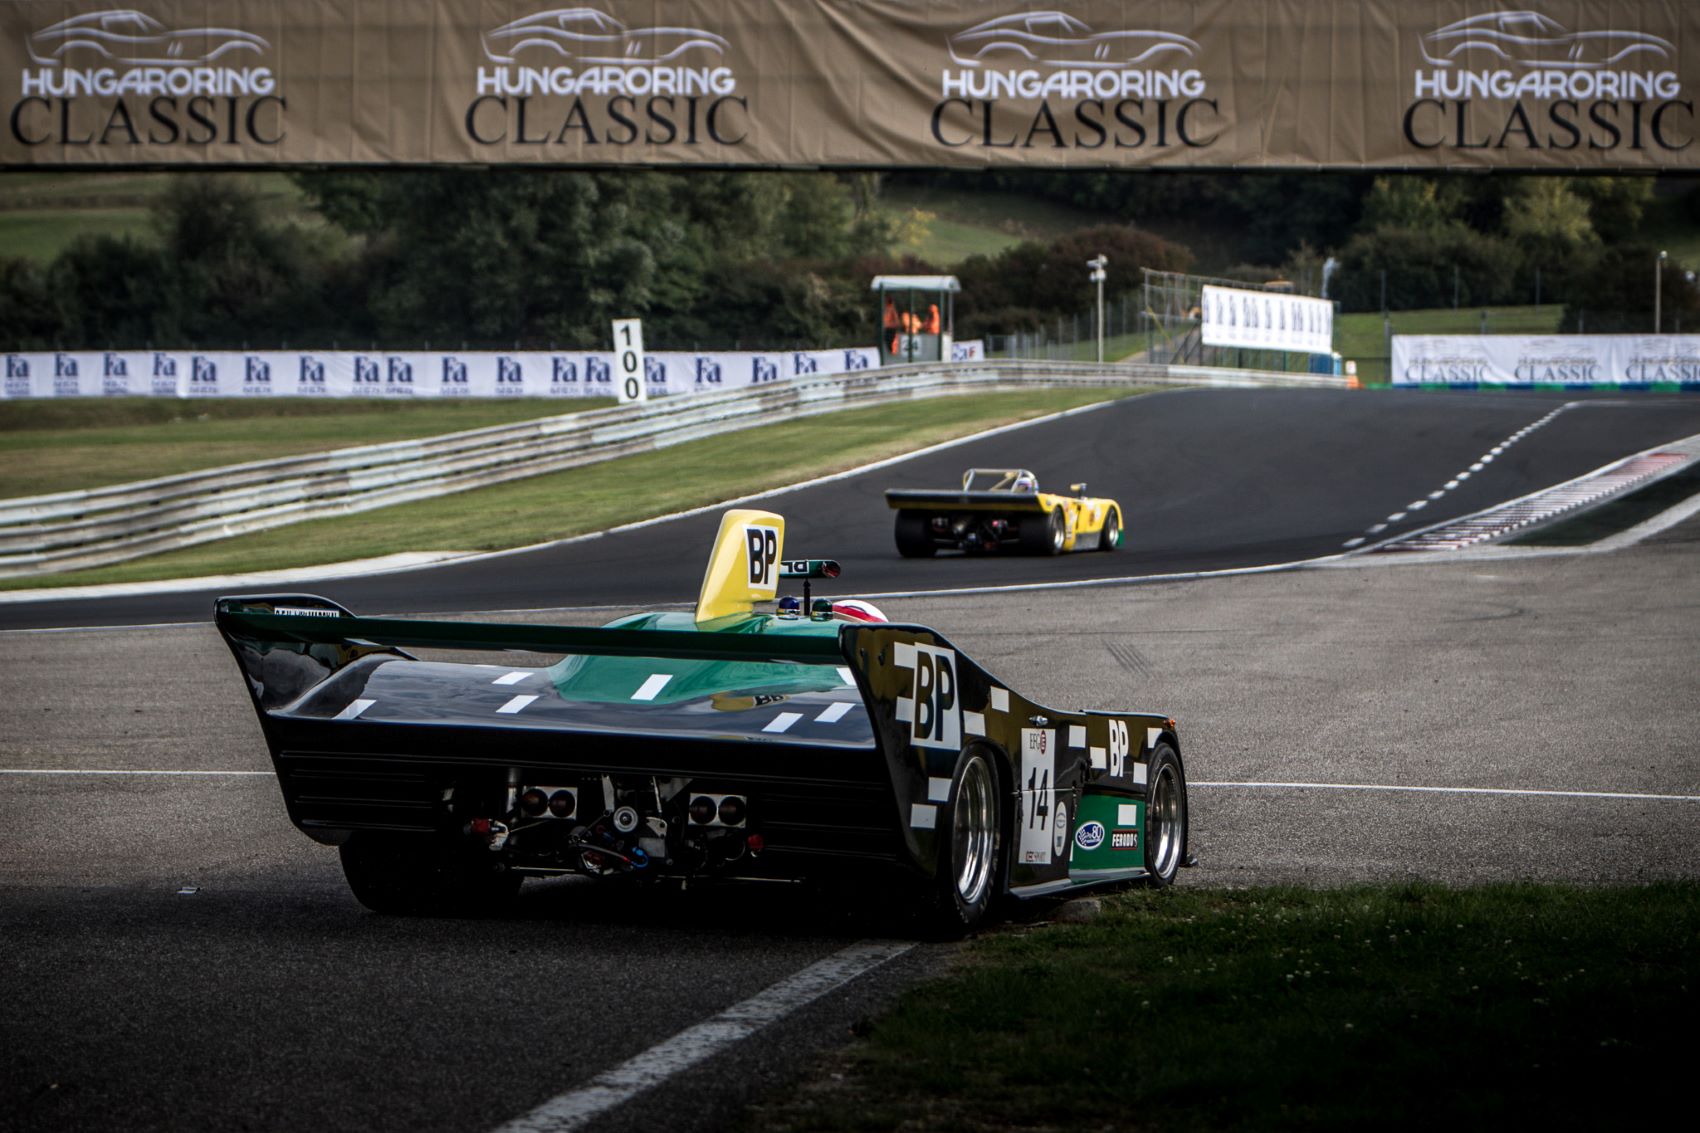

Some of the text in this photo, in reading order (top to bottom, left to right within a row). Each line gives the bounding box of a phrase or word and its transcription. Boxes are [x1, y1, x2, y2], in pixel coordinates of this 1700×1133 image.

[22, 67, 275, 96] HUNGARORING
[477, 66, 736, 96] HUNGARORING
[942, 69, 1206, 100] HUNGARORING
[1414, 69, 1681, 100] HUNGARORING
[9, 94, 287, 146] CLASSIC
[465, 94, 750, 146] CLASSIC
[931, 98, 1219, 149] CLASSIC
[1402, 98, 1695, 151] CLASSIC
[6, 354, 30, 378] Fa
[55, 353, 78, 376] Fa
[104, 352, 128, 376] Fa
[153, 353, 176, 376] Fa
[192, 356, 217, 382] Fa
[245, 356, 271, 382] Fa
[299, 356, 325, 382] Fa
[353, 356, 380, 382] Fa
[387, 356, 414, 382] Fa
[441, 356, 468, 383] Fa
[496, 356, 523, 382] Fa
[552, 356, 578, 382] Fa
[585, 356, 612, 382] Fa
[620, 323, 639, 399] 100
[695, 357, 721, 383] Fa
[752, 357, 777, 382] Fa
[1406, 364, 1491, 382] CLASSIC
[1514, 364, 1602, 380] CLASSIC
[1625, 364, 1700, 380] CLASSI
[747, 528, 777, 584] BP
[915, 651, 955, 742] BP
[1109, 719, 1129, 777] BP
[1028, 767, 1048, 830] 14
